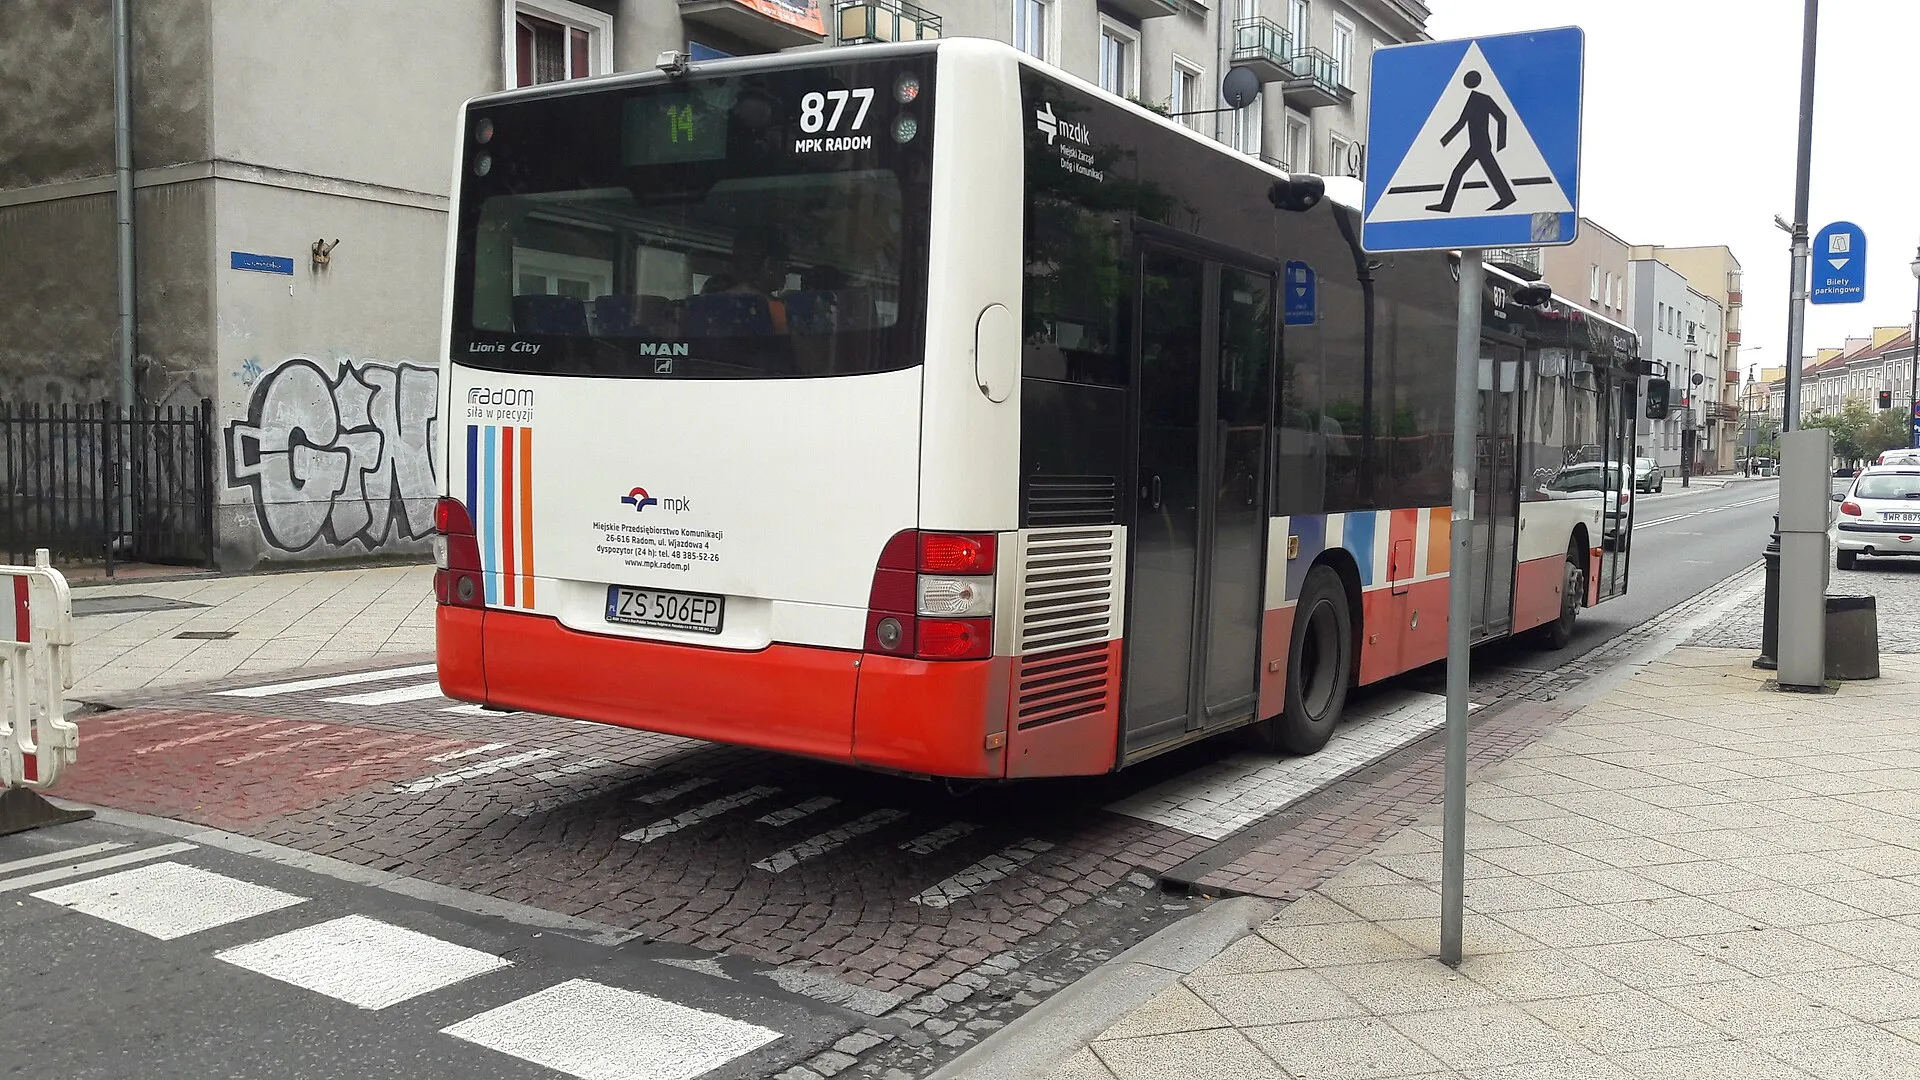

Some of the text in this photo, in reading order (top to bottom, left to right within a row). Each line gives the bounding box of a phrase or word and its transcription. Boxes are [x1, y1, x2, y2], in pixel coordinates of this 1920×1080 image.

[799, 88, 875, 133] 877
[666, 104, 694, 143] 14
[795, 136, 871, 153] MPK RADOM
[1815, 286, 1860, 295] parkingowe
[1826, 278, 1849, 286] Bilety
[1493, 285, 1506, 309] 877
[469, 341, 541, 355] Lion's City
[640, 343, 689, 356] MAN
[467, 387, 534, 407] radom
[467, 406, 534, 423] siła w precyzji
[663, 496, 691, 514] mpk
[1888, 513, 1901, 521] WR
[592, 522, 723, 540] Miejskie Przedsiębiorstwo Komunikacji
[605, 534, 631, 543] 26-616
[631, 536, 657, 546] Radom,
[657, 539, 667, 547] ul.
[668, 539, 703, 550] Wjazdowa
[596, 544, 633, 556] dyspozytor
[634, 547, 647, 557] (24
[658, 550, 670, 558] tel.
[671, 551, 681, 559] 48
[682, 552, 720, 562] 385-52-26
[624, 559, 691, 572] www.mpk.radom.pl
[619, 591, 648, 617] ZS
[654, 594, 717, 624] 506EP
